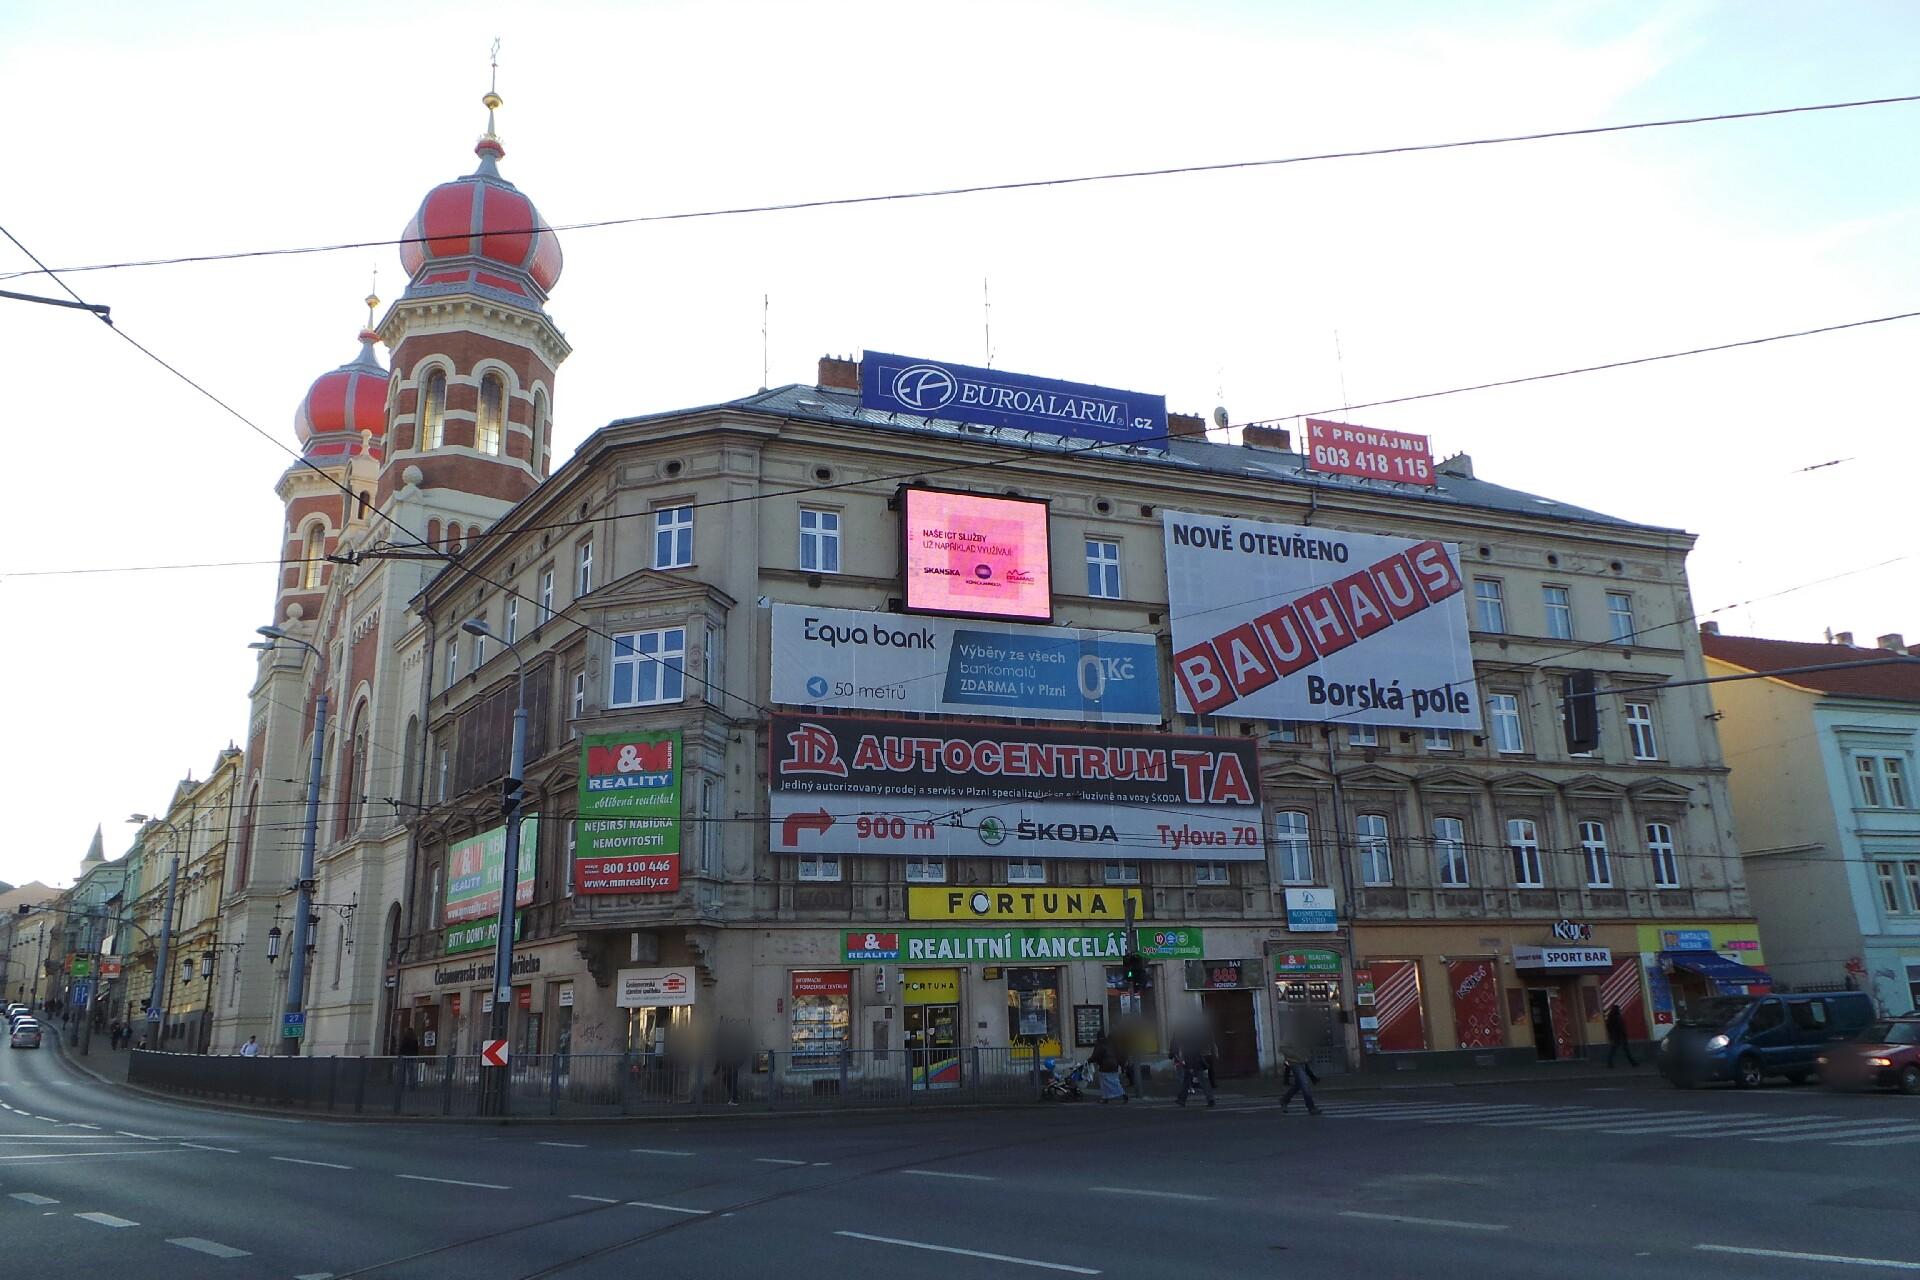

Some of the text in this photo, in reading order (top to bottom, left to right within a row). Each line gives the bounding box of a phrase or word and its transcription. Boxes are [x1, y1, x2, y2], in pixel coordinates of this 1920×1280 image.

[960, 383, 1118, 424] EUROALARM
[1312, 426, 1424, 452] K PRONÁJMU
[1315, 445, 1428, 478] 603 418 115
[923, 529, 986, 542] NAŠE ICT SLUŽBY
[923, 540, 932, 549] UŽ
[1173, 524, 1348, 564] NOVĚ OTEVŘENO
[924, 567, 960, 576] SKANSKA
[804, 618, 936, 649] Equa bank
[1179, 548, 1450, 704] BAUHAUS
[960, 644, 1066, 664] Výběry ze všech
[960, 662, 1036, 678] bankomatů
[1076, 654, 1135, 700] 0 Kč
[834, 681, 906, 700] 50 metrů
[960, 680, 1017, 694] ZDARMA
[1028, 686, 1035, 694] v
[1039, 684, 1066, 696] Plzni
[1308, 675, 1470, 718] Borská pole
[852, 734, 1254, 804] AUTOCENTRUM TA
[590, 774, 668, 789] REALITY
[780, 780, 814, 793] Jediný
[816, 783, 882, 794] autorizovaný
[885, 785, 916, 796] prodej
[928, 786, 955, 794] servis
[966, 787, 990, 796] Plzni
[1130, 794, 1149, 803] vozy
[1152, 794, 1180, 802] ŠKODA
[857, 817, 934, 839] 900 m
[1018, 819, 1118, 842] ŠKODA
[1158, 824, 1257, 850] Tylova 70
[593, 834, 664, 848] NEMOVITOSTÍ!
[602, 860, 670, 874] 800 100 446
[584, 876, 669, 888] www.mmreality.cz
[948, 890, 1108, 915] FORTUNA
[466, 926, 484, 944] DOMY
[908, 932, 1012, 959] REALITNÍ
[1547, 952, 1608, 962] SPORT BAR
[906, 982, 954, 991] FORTUNA
